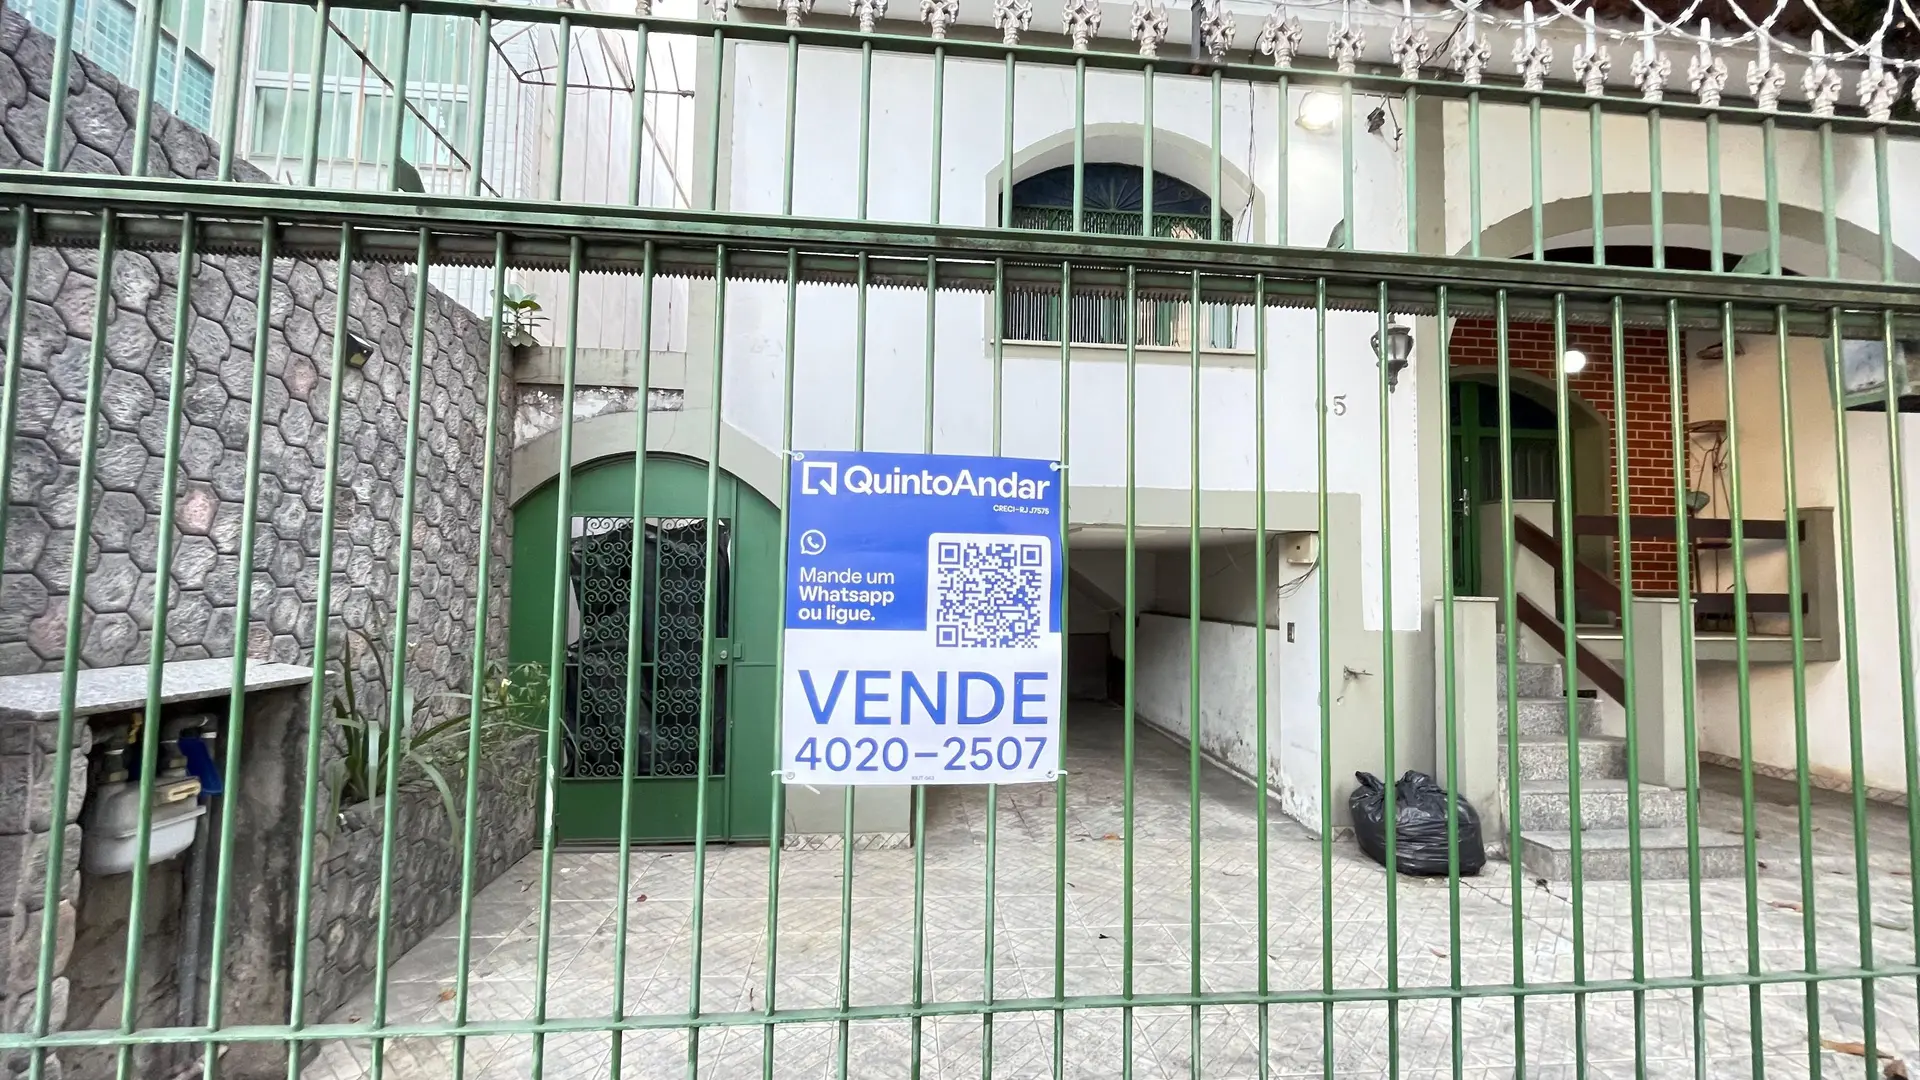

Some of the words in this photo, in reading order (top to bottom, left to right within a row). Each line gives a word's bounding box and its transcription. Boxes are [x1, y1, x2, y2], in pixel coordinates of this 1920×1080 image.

[844, 465, 1051, 501] QuintoAndar
[993, 504, 1029, 514] CRECI-RJ
[799, 567, 863, 585] Mande
[866, 571, 895, 585] um
[799, 586, 895, 606] Whatsapp
[798, 607, 823, 621] ou
[825, 604, 876, 625] ligue.
[798, 669, 1049, 726] VENDE
[795, 736, 1048, 772] 4020-2507
